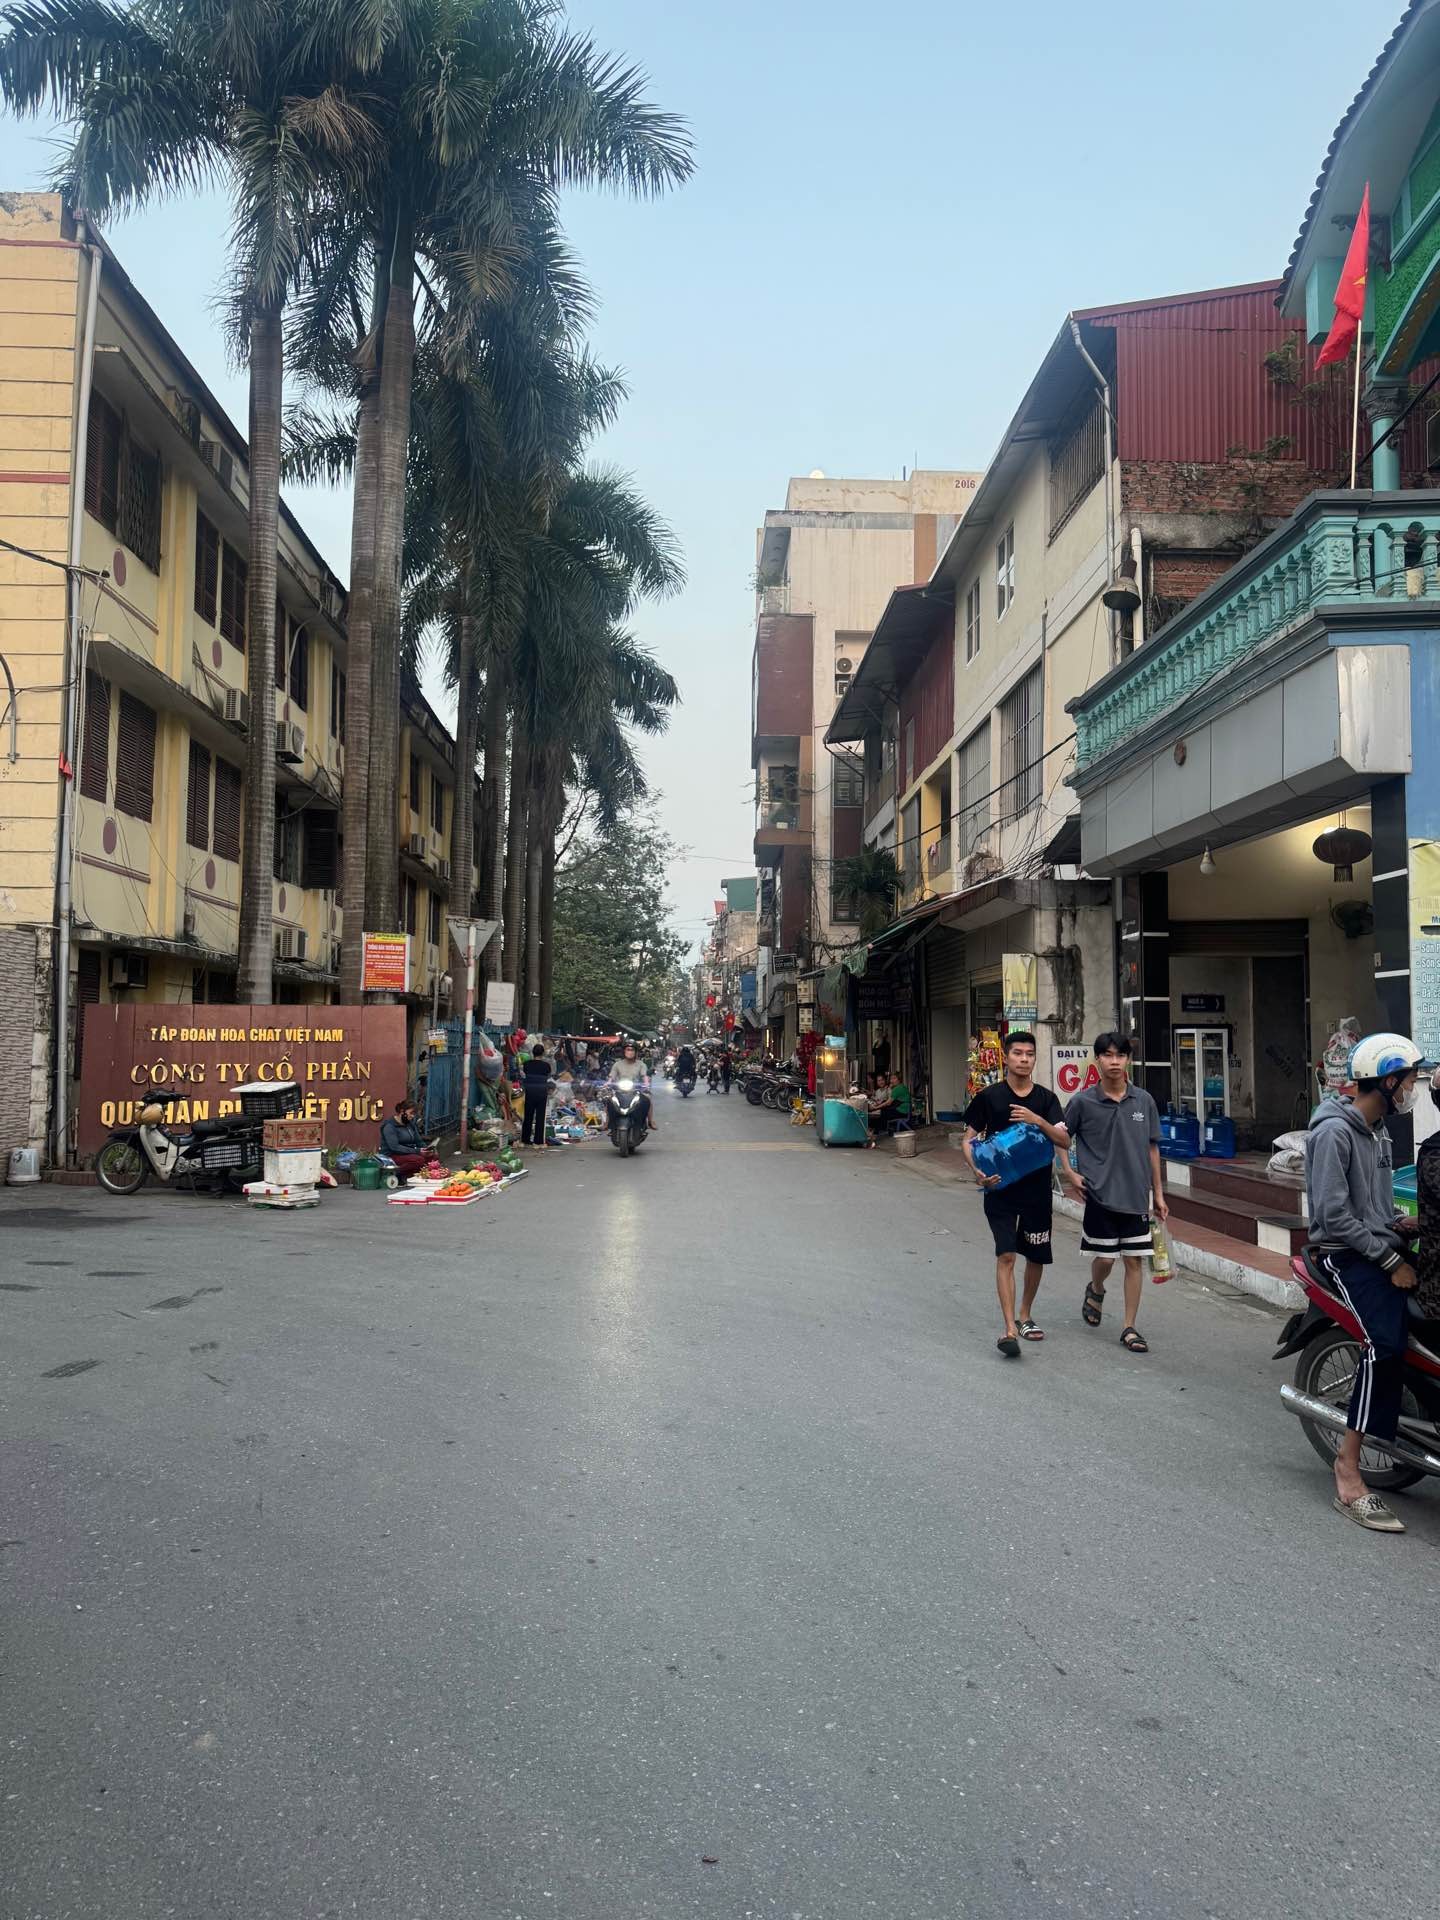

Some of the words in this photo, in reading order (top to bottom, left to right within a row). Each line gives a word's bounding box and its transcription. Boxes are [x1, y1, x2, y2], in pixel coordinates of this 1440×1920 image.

[954, 479, 976, 489] 2016
[284, 1026, 311, 1045] VIỆT
[314, 1028, 344, 1042] NAM
[1057, 1050, 1075, 1060] ĐẠI
[130, 1057, 206, 1084] CÔNG
[215, 1063, 250, 1082] TY
[1057, 1063, 1128, 1093] GA
[338, 1090, 384, 1121] ĐỨC
